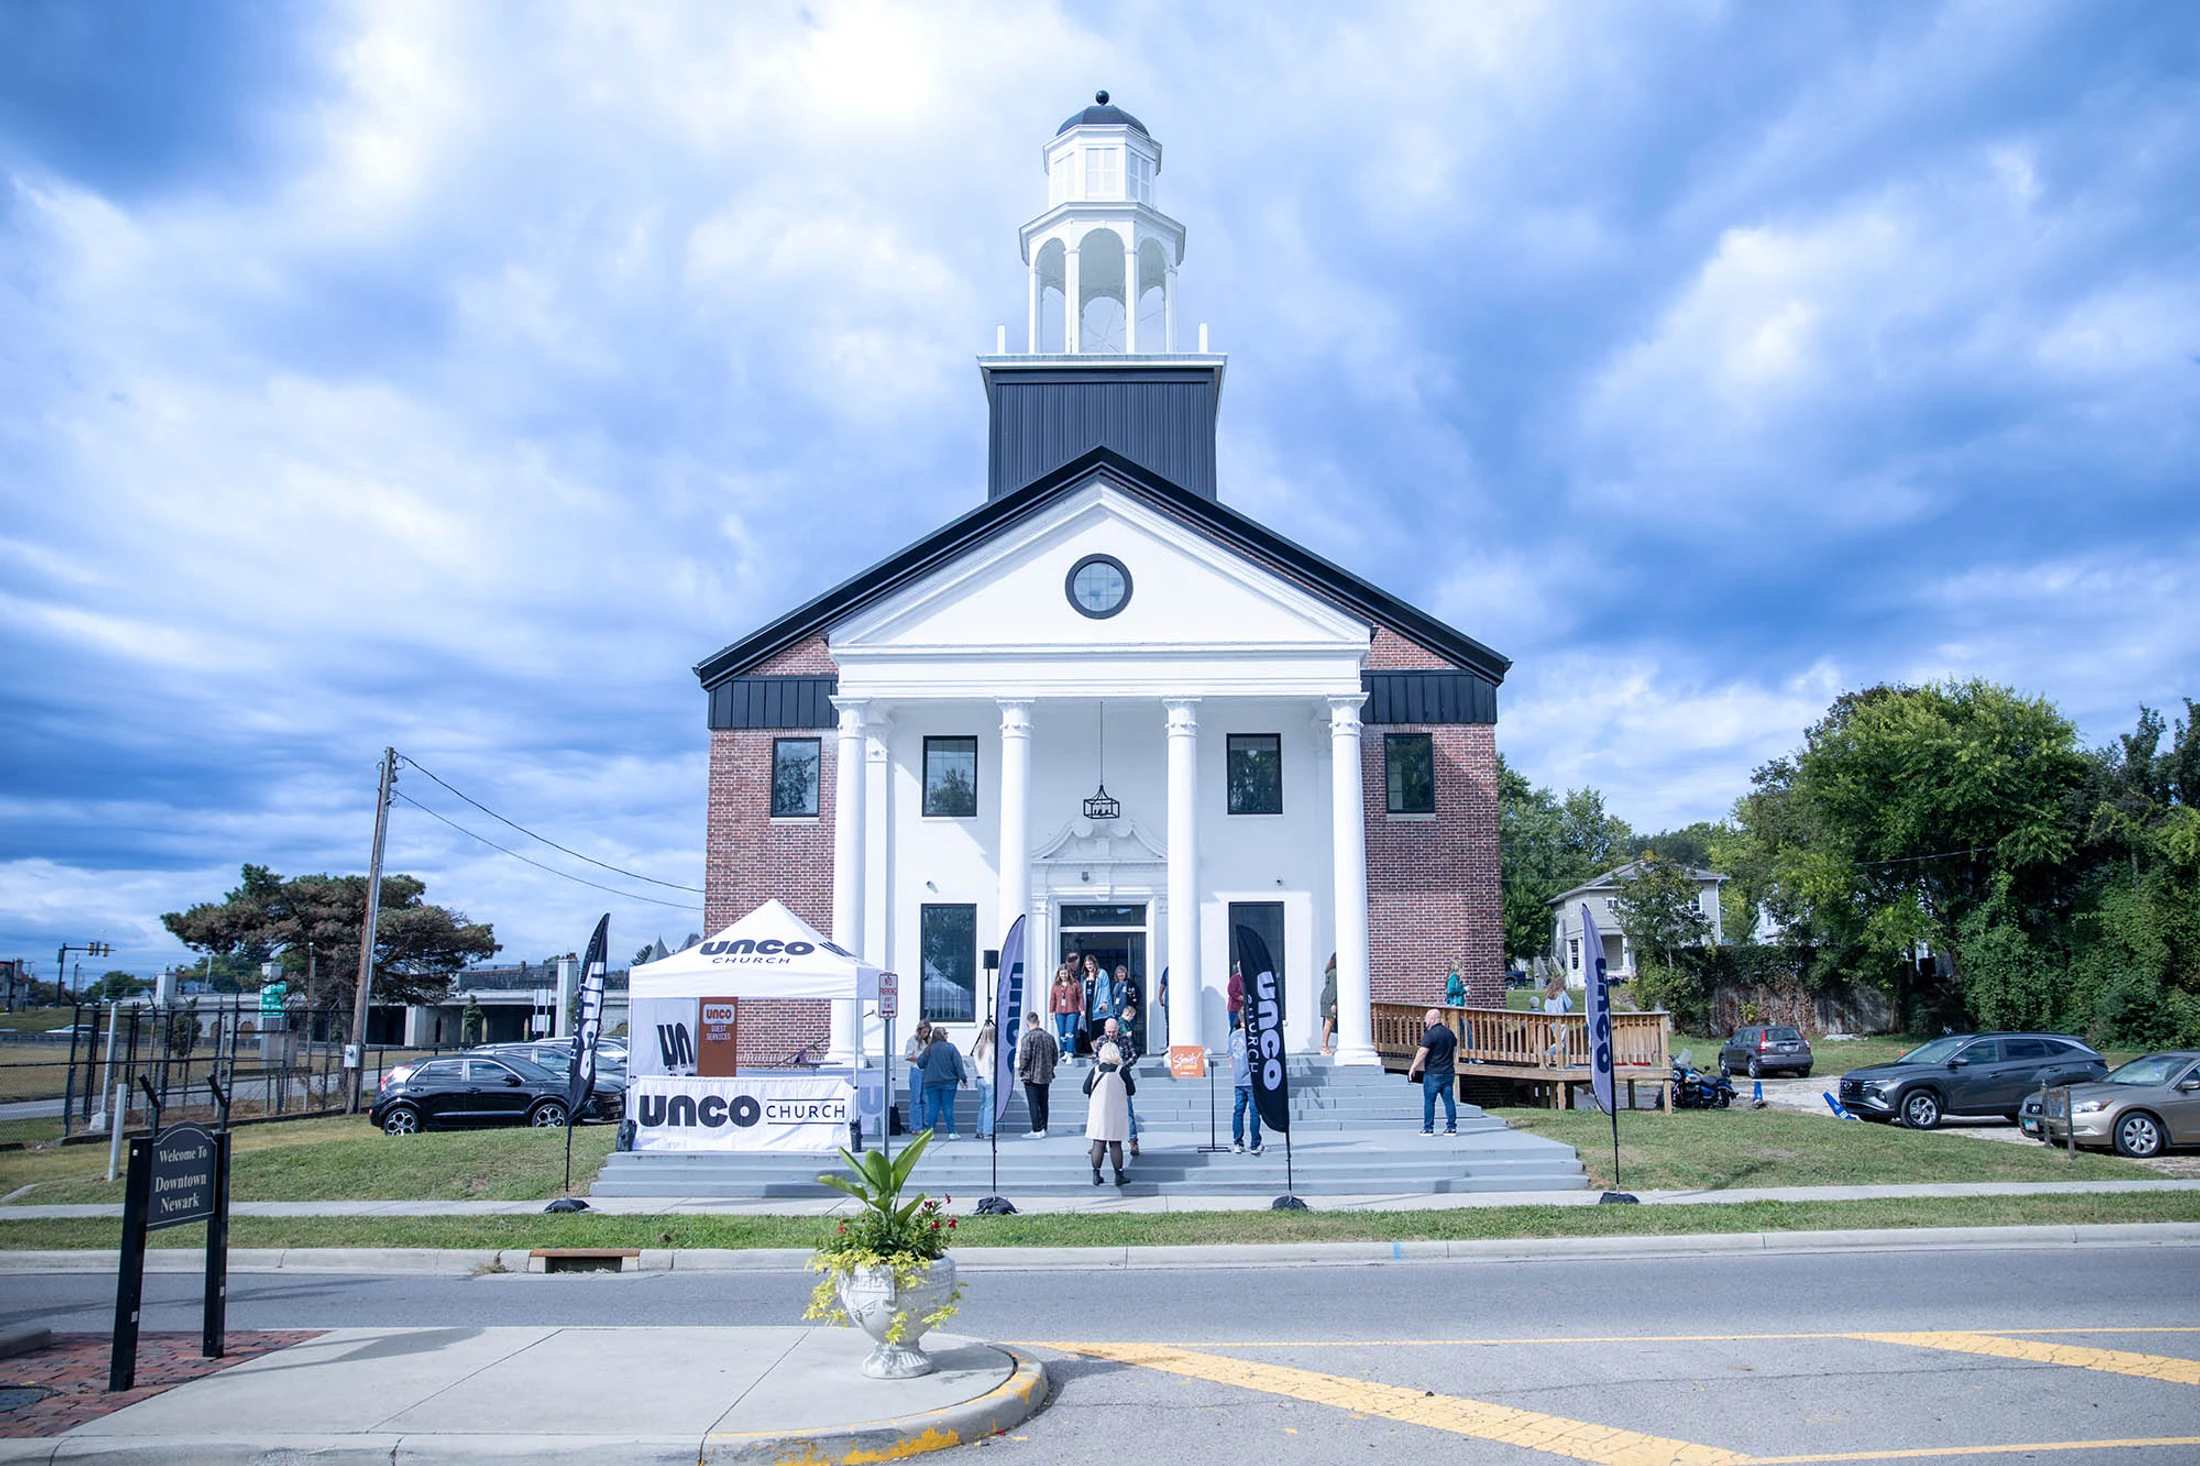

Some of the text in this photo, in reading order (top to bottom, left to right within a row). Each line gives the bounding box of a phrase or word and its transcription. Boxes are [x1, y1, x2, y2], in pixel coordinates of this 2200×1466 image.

[766, 1105, 845, 1118] CHURCH
[159, 1145, 208, 1162] Welcome To
[155, 1173, 207, 1193] Downtown
[160, 1192, 200, 1213] Newark
